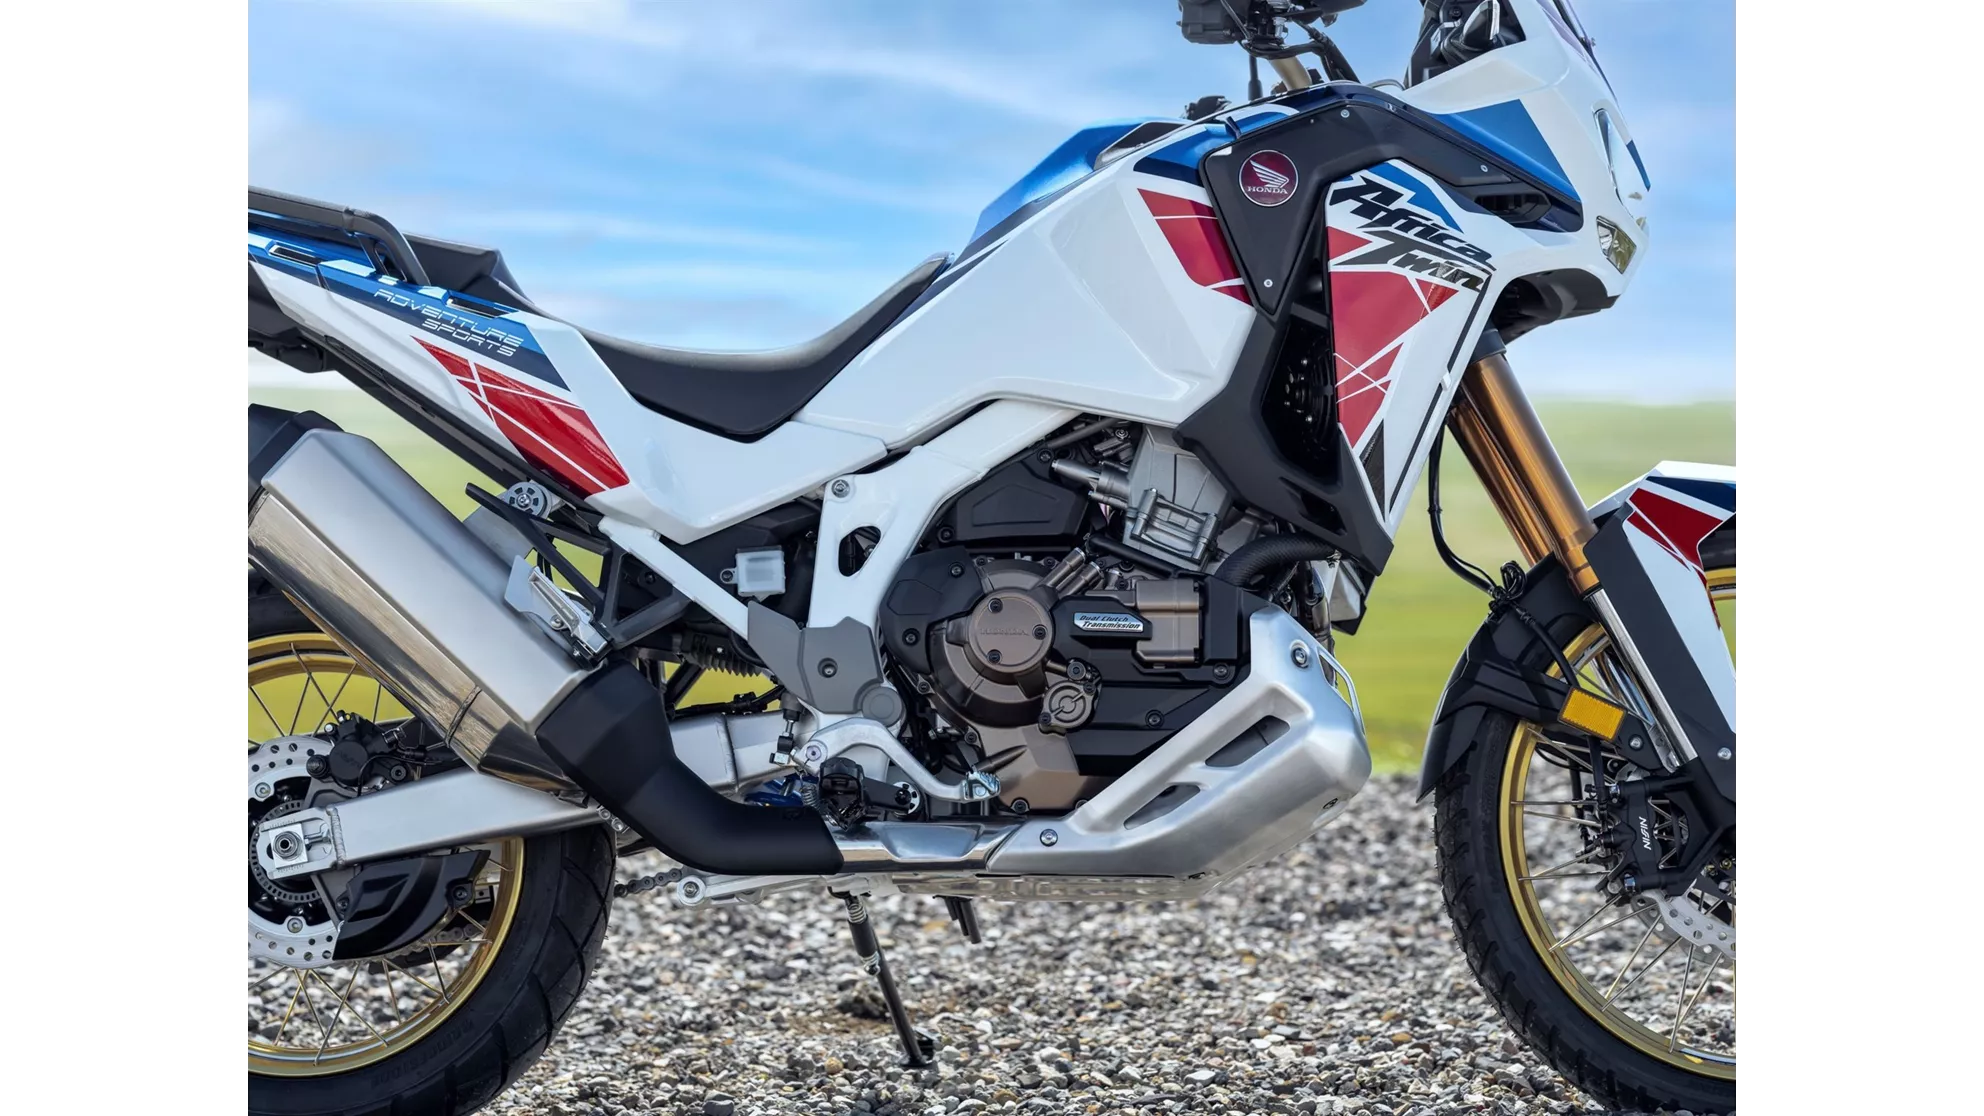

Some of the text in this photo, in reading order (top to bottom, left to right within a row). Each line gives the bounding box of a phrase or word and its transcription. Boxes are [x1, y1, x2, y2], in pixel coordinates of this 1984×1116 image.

[1247, 186, 1288, 195] HONDA
[1329, 175, 1497, 271] Africa
[1332, 229, 1493, 292] Twin
[373, 288, 524, 348] ADVENTURE
[421, 318, 517, 357] SPORTS
[1082, 621, 1141, 629] Transmission
